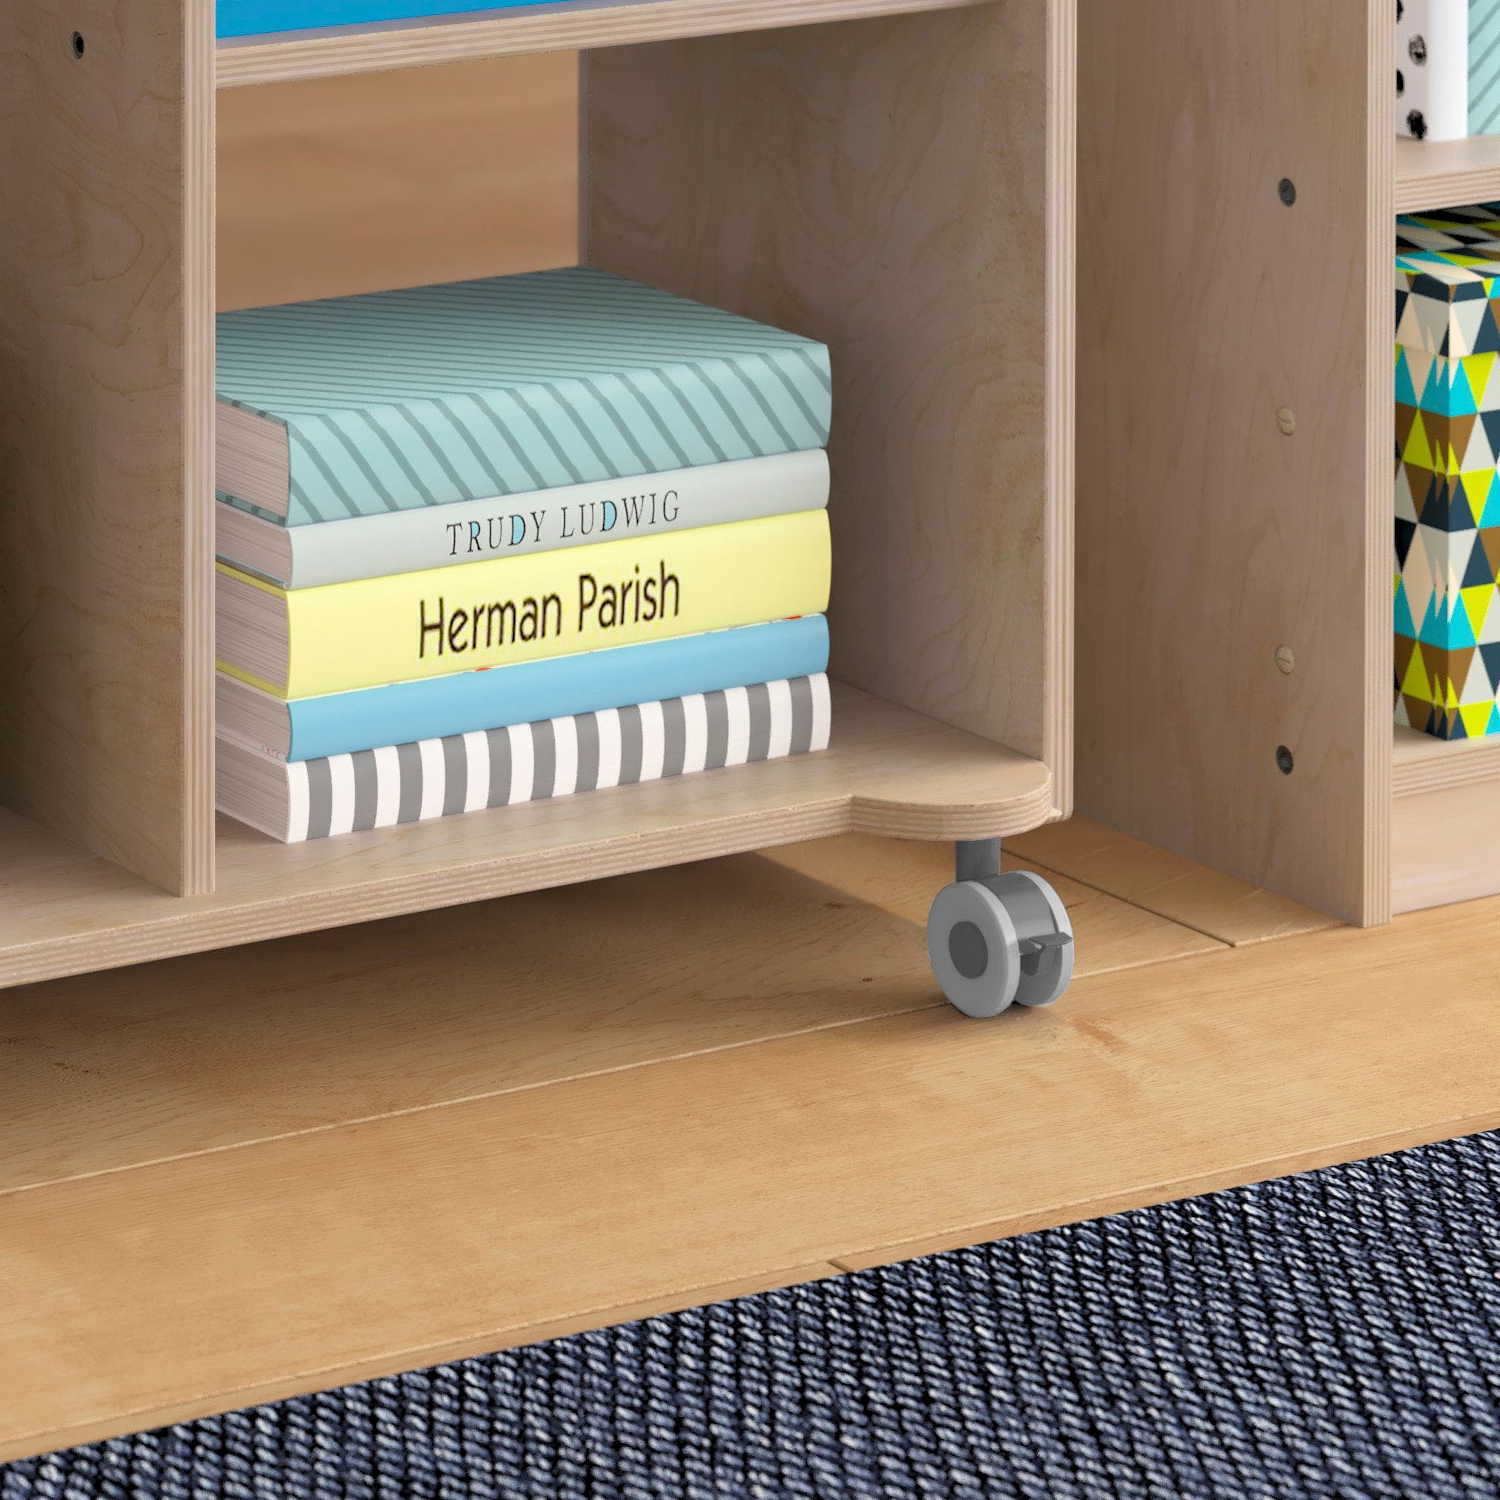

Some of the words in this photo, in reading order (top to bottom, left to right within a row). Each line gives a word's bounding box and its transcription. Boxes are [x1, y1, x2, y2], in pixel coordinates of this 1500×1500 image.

[446, 510, 547, 556] TRUDY
[559, 490, 680, 539] LUDWIG
[418, 592, 562, 658] Herman
[578, 560, 680, 632] Parish
